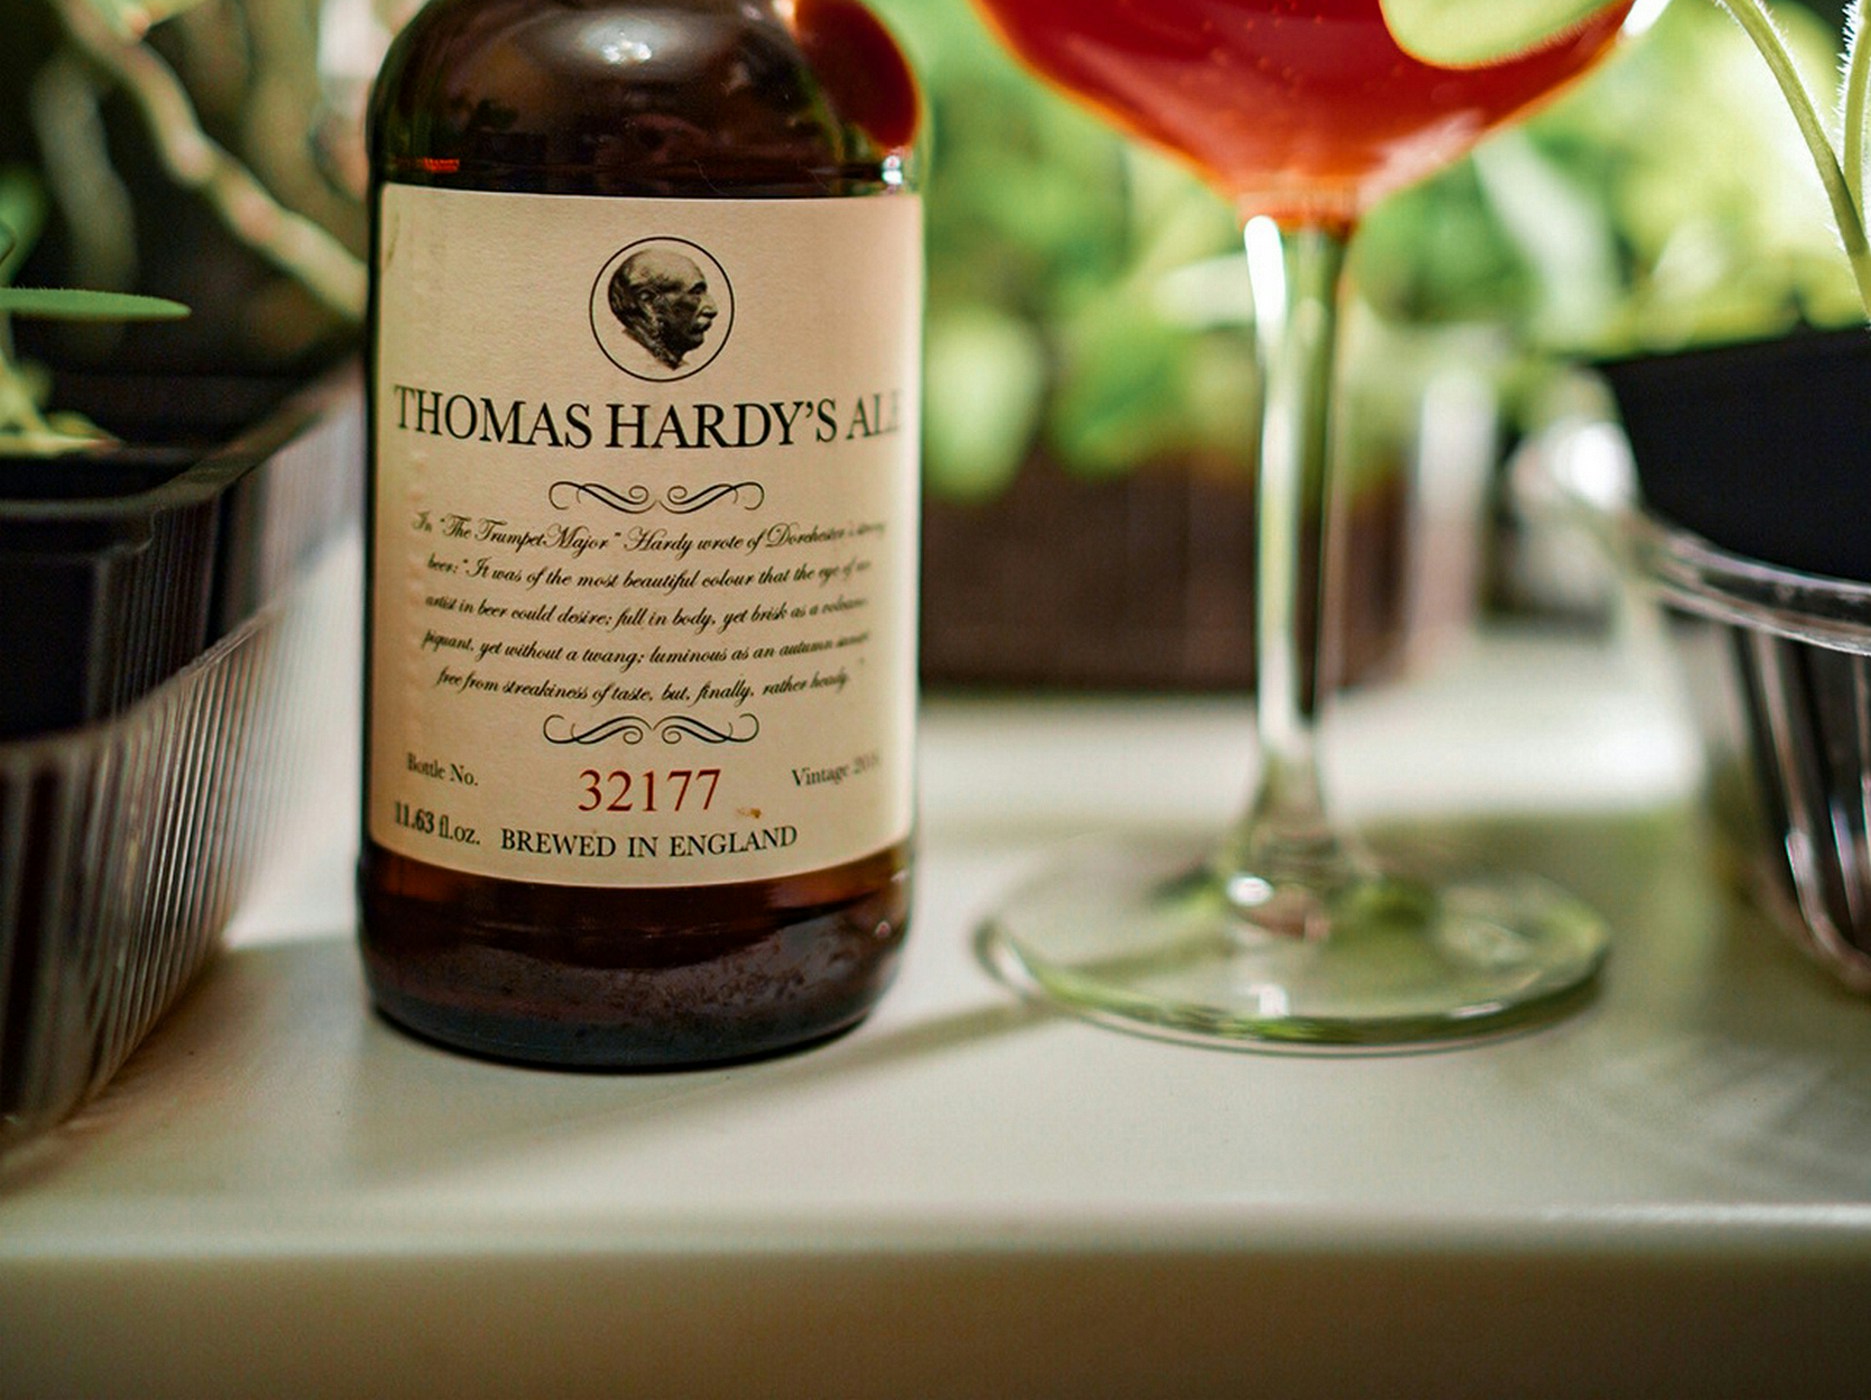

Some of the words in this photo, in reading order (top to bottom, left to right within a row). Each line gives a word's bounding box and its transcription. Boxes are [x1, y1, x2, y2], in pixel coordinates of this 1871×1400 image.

[394, 384, 593, 448] THOMAS
[605, 397, 838, 449] HARDY'S
[474, 517, 546, 553] Trumpet
[624, 525, 694, 561] Hardy
[697, 534, 744, 551] wrote
[746, 528, 768, 556] of
[492, 567, 522, 583] was
[525, 566, 546, 591] of
[546, 567, 573, 587] the
[576, 573, 620, 588] most
[622, 570, 702, 596] beautiful
[701, 568, 754, 588] colour
[757, 565, 791, 585] that
[793, 563, 815, 581] the
[458, 599, 474, 614] in
[478, 598, 508, 618] beer
[510, 604, 558, 622] could
[609, 607, 647, 633] full
[648, 611, 668, 626] in
[717, 609, 748, 635] yet
[750, 601, 788, 622] brisk
[790, 605, 806, 619] as
[808, 603, 819, 616] a
[478, 641, 503, 664] yet
[505, 641, 562, 661] without
[565, 648, 578, 661] a
[648, 645, 728, 664] luminous
[730, 646, 750, 662] as
[752, 647, 775, 660] an
[778, 638, 833, 656] autumn
[435, 666, 463, 688] free
[458, 670, 500, 694] from
[502, 679, 588, 700] streakiness
[590, 683, 611, 708] of
[762, 674, 809, 696] rather
[406, 751, 447, 779] Bottle
[449, 763, 479, 787] No.
[791, 763, 850, 787] Vintage
[577, 768, 722, 813] 32177
[394, 800, 435, 834] 11.63
[500, 827, 617, 858] BREWED
[627, 835, 659, 858] IN
[668, 824, 799, 858] ENGLAND
